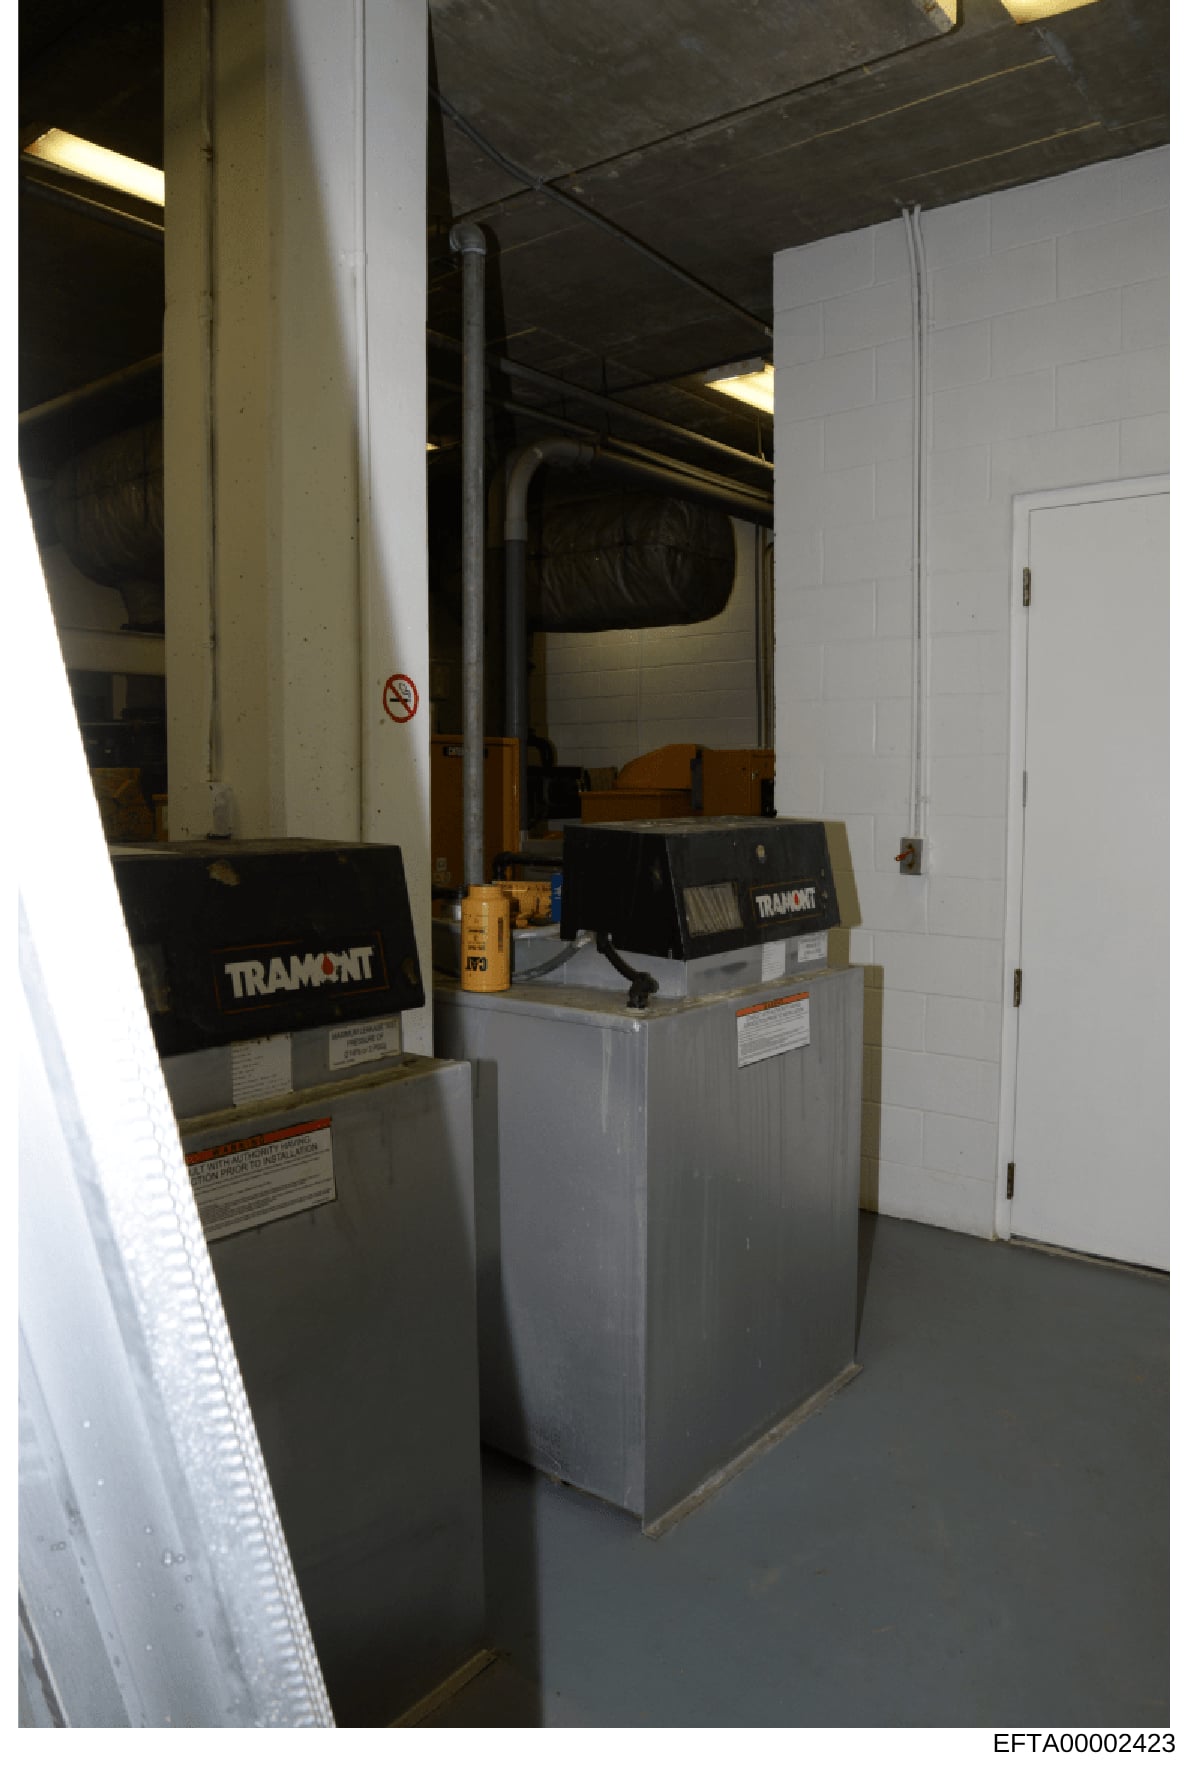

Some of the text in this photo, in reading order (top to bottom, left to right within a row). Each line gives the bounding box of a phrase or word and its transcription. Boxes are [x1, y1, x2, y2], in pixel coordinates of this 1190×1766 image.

[755, 887, 816, 918] TRAMONT
[224, 946, 374, 999] TRAMONT
[465, 956, 488, 971] CAT
[207, 1159, 230, 1172] WITH
[231, 1144, 278, 1164] AUTHORITY
[281, 1135, 310, 1150] HAVING
[220, 1162, 248, 1178] PRIOR
[250, 1159, 261, 1170] TO
[263, 1142, 318, 1165] INSTALLATION
